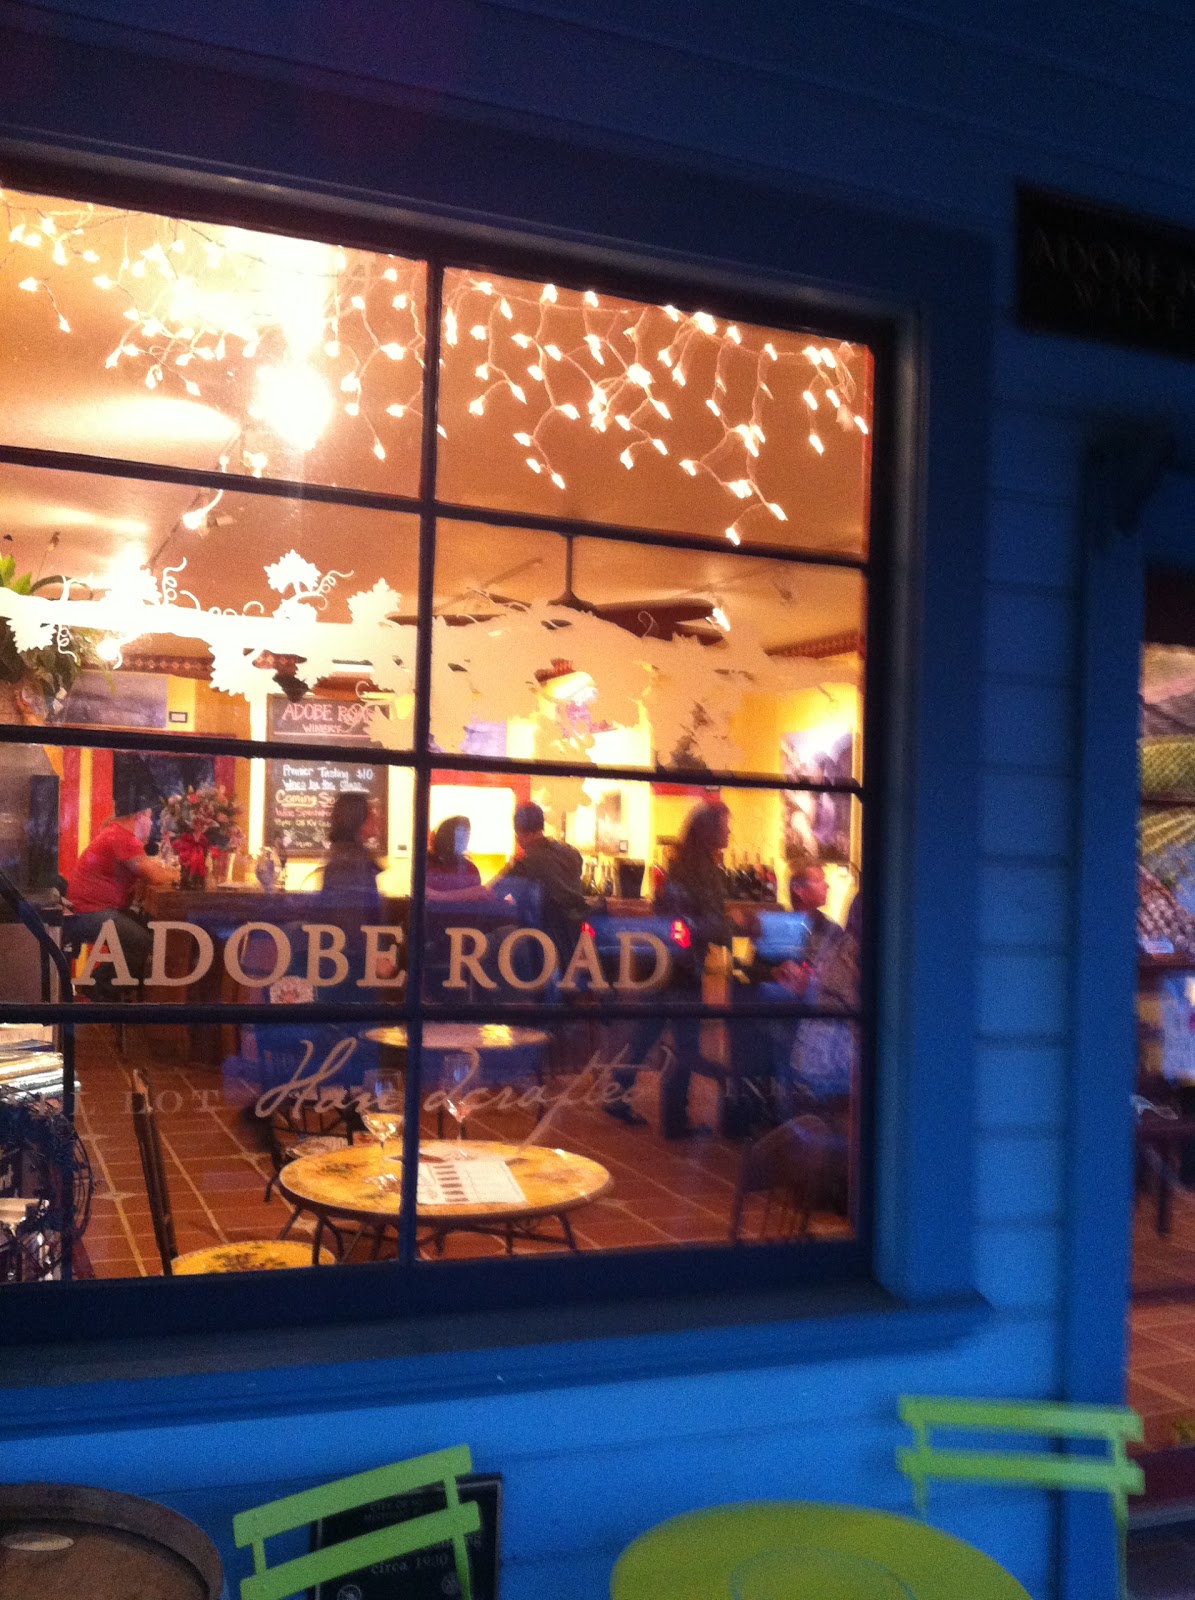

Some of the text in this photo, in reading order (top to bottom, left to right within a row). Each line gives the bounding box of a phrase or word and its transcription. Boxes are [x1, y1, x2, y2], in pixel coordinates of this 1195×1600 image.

[282, 703, 333, 722] ADOBE
[302, 724, 345, 735] WINERY
[356, 768, 374, 780] $10
[275, 788, 317, 806] Coming
[72, 920, 671, 991] ADOBE ROAD
